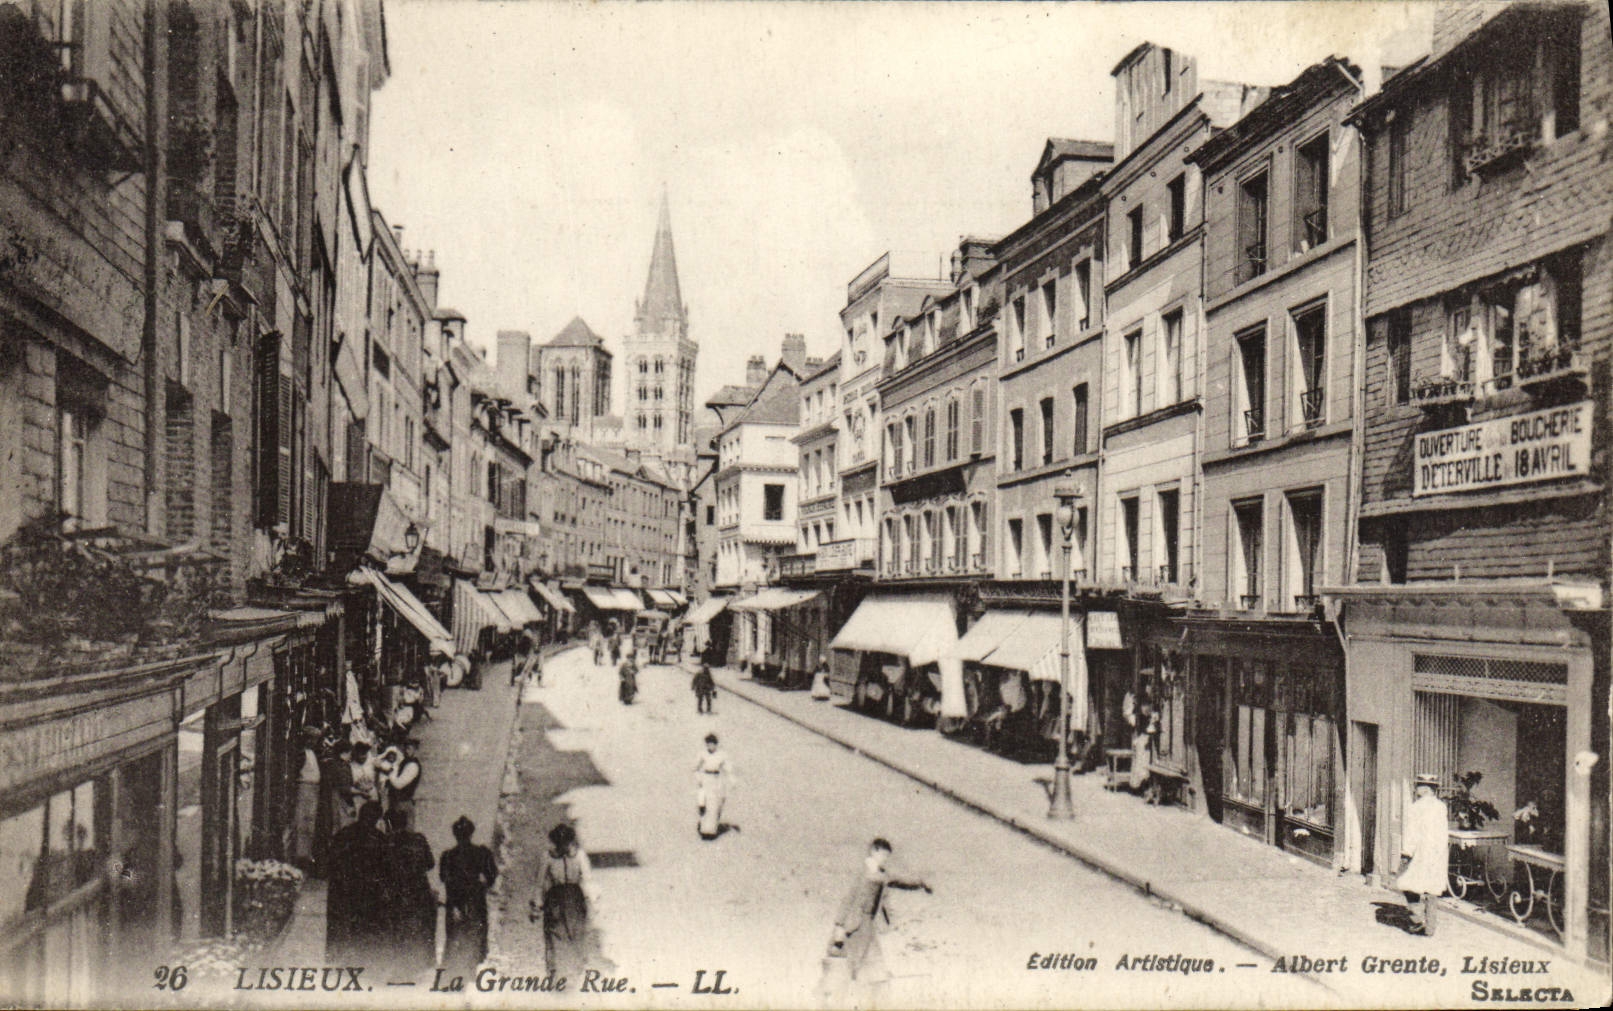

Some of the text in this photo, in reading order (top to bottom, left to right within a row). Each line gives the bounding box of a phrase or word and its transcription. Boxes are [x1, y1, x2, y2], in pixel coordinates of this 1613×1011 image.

[1420, 428, 1483, 459] OUVERTURE
[1511, 406, 1583, 445] BOUCHERIE
[1515, 448, 1530, 478] 18
[1532, 443, 1577, 475] AVRIL
